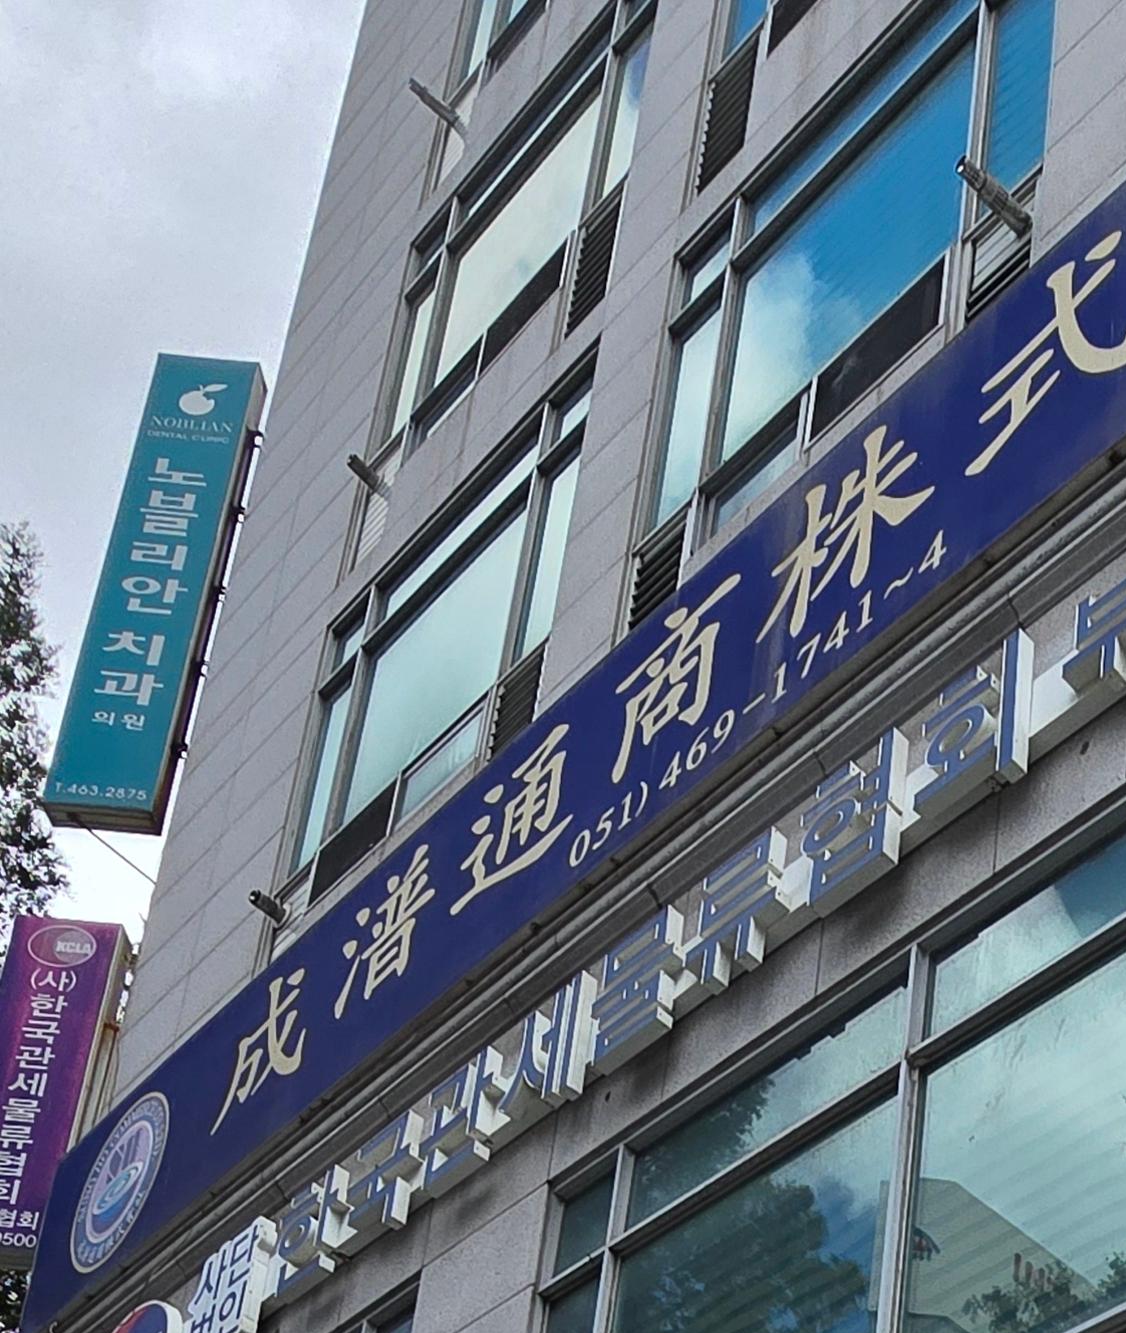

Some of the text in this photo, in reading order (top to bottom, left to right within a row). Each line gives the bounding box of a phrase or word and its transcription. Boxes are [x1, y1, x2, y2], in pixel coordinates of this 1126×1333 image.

[151, 416, 233, 433] NOBLIAN
[147, 430, 187, 441] DENTAL
[91, 710, 145, 731] 의원
[55, 782, 148, 801] T.463.2875
[569, 782, 648, 868] 051)
[56, 940, 91, 954] KCLA
[0, 1232, 37, 1248] 500
